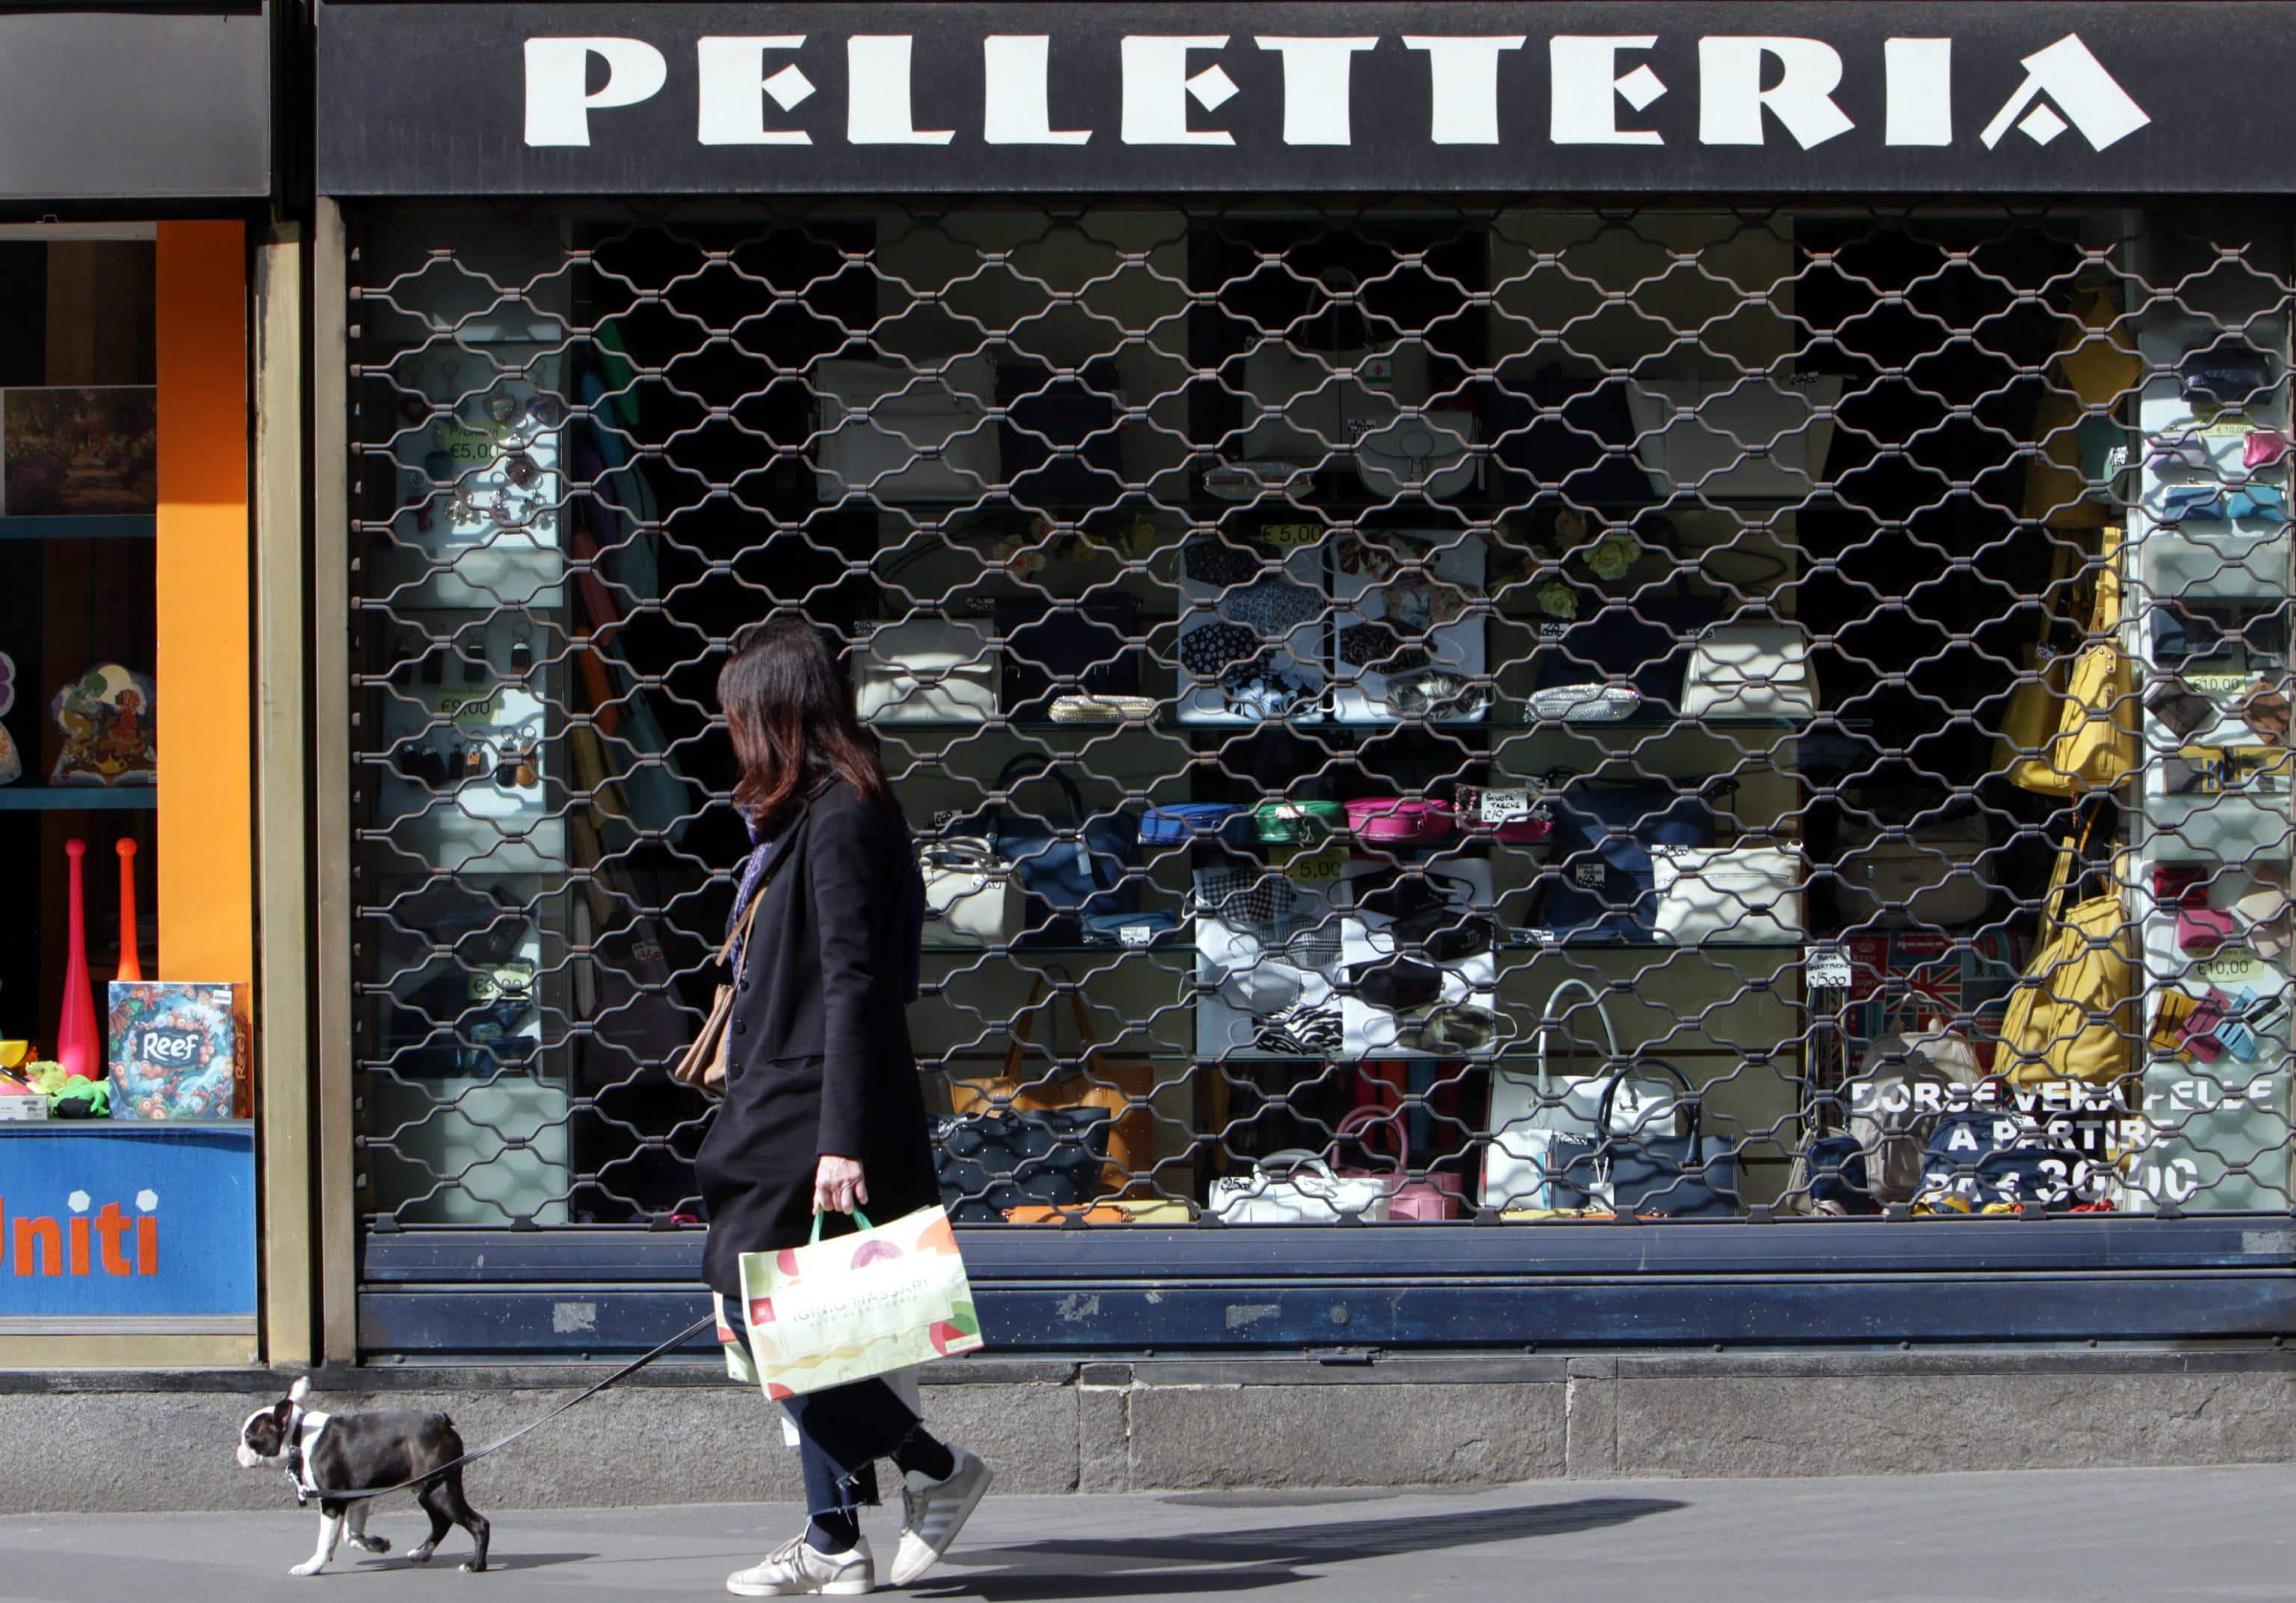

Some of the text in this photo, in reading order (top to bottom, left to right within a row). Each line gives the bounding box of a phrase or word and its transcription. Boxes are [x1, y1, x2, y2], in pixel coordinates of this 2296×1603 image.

[525, 34, 2150, 152] PELLETTERIA
[143, 1031, 200, 1061] Reef
[1852, 1081, 2273, 1113] BORSE VERA PELLE
[1947, 1119, 2176, 1151] A PARTIRE
[0, 1188, 159, 1276] niti
